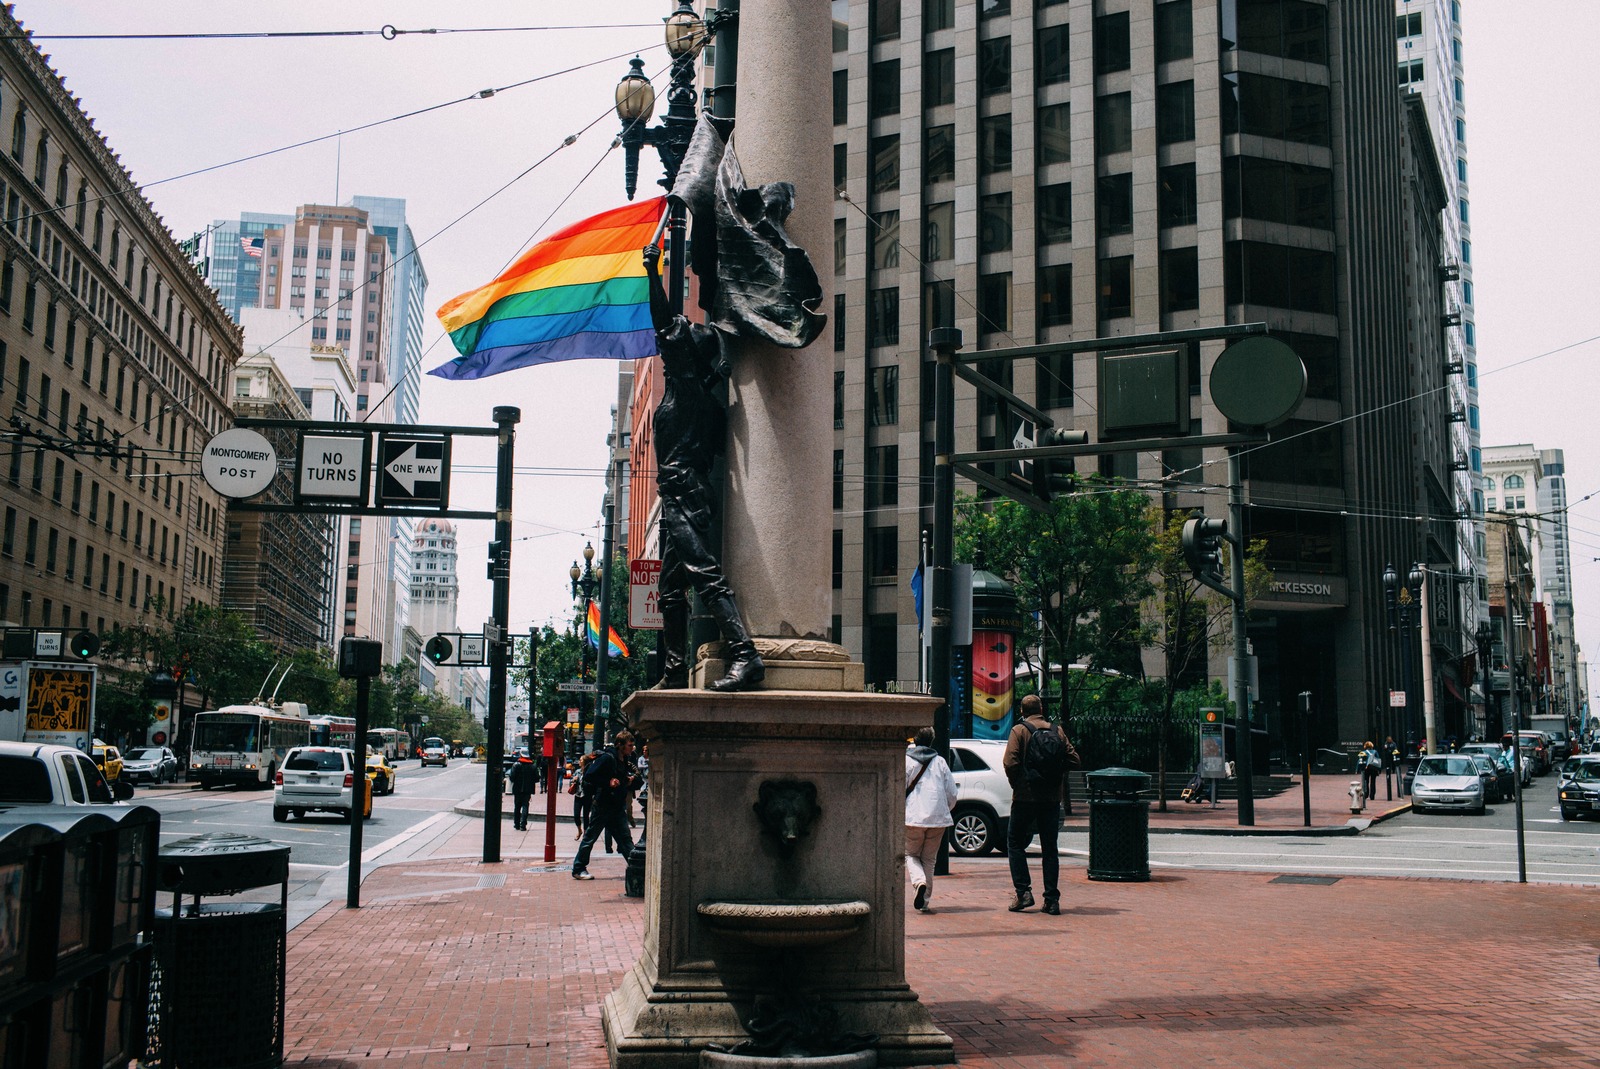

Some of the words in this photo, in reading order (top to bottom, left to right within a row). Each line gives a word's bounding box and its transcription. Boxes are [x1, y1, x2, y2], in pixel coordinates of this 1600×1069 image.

[210, 447, 270, 462] MONTGOMERY
[322, 452, 343, 465] NO
[219, 467, 257, 479] POST
[307, 468, 357, 482] TURNS
[392, 464, 413, 474] ONE
[418, 465, 438, 475] WAY
[632, 571, 648, 584] NO
